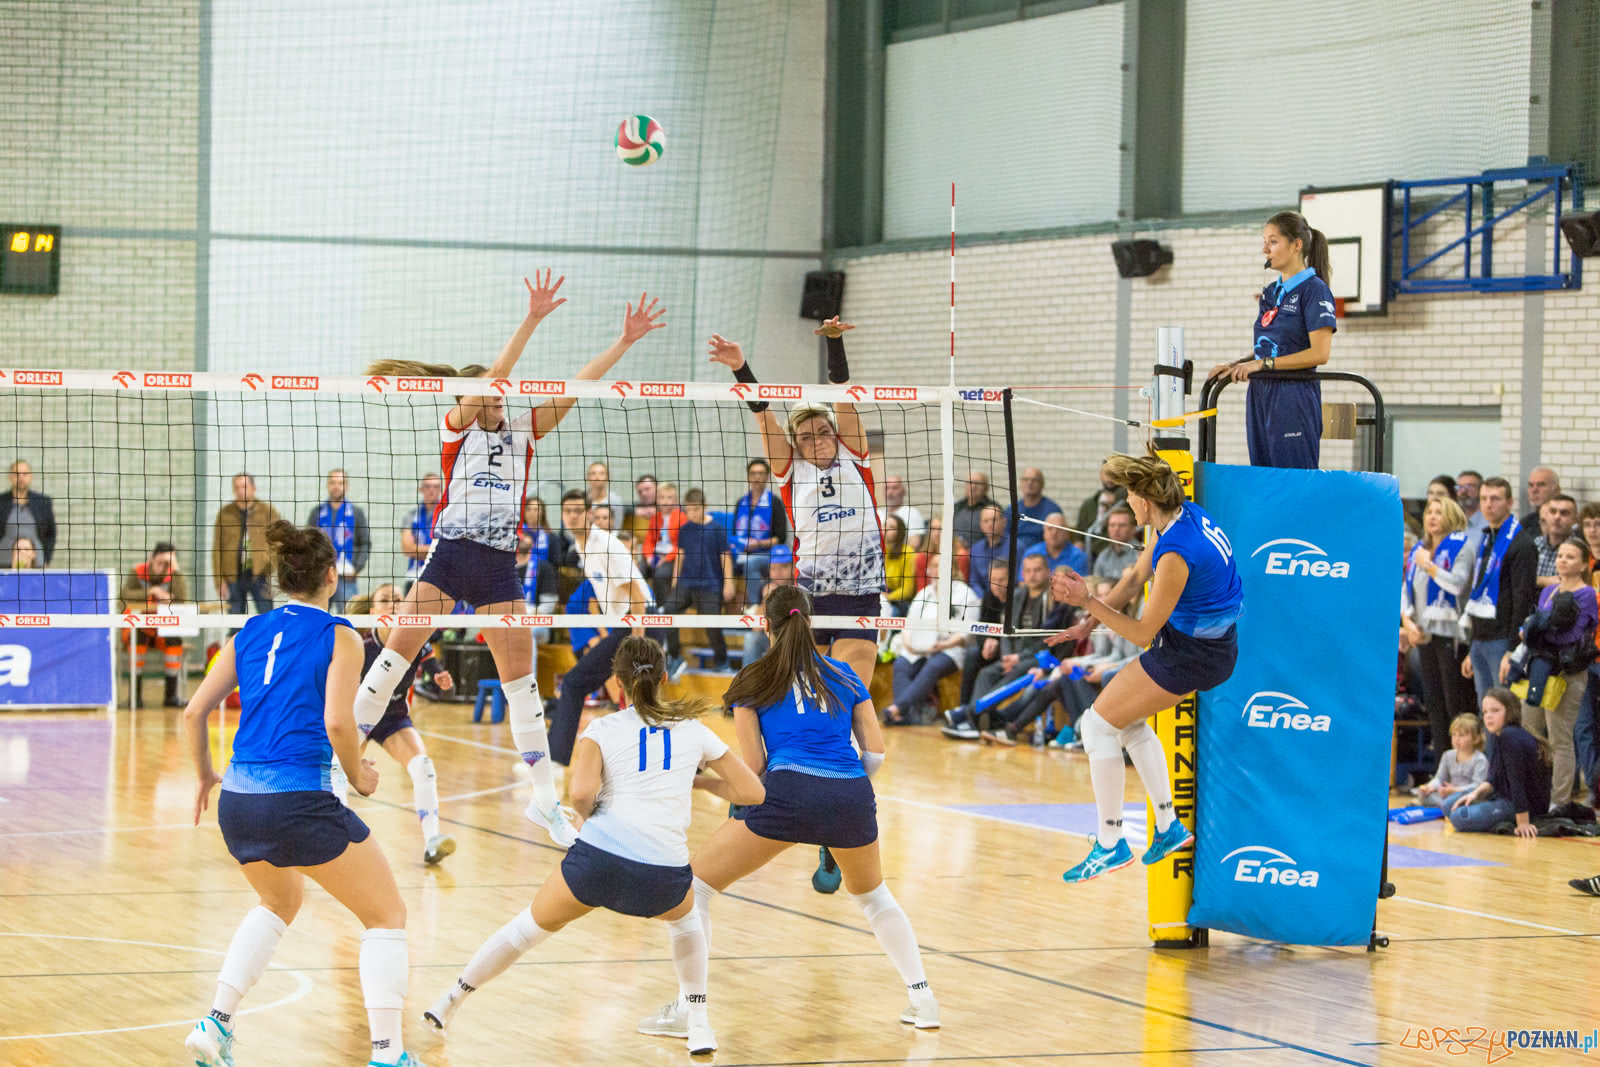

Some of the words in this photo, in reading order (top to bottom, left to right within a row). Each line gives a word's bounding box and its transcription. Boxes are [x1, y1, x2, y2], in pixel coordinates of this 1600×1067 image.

[16, 372, 60, 383] ORLEN
[147, 375, 189, 386] ORLEN
[274, 378, 317, 388] ORLEN
[399, 381, 441, 391] ORLEN
[522, 383, 563, 393] ORLEN
[642, 385, 682, 395] ORLEN
[760, 387, 800, 397] ORLEN
[876, 389, 915, 399] ORLEN
[958, 388, 1003, 401] netex
[488, 444, 504, 467] 2
[472, 478, 511, 491] Enea
[820, 476, 836, 498] 3
[818, 508, 856, 523] Enea
[1201, 516, 1233, 567] 16
[1265, 552, 1350, 579] Enea
[17, 616, 49, 625] ORLEN
[147, 616, 178, 625] ORLEN
[400, 616, 430, 625] ORLEN
[522, 616, 552, 625] ORLEN
[643, 616, 672, 625] ORLEN
[876, 619, 904, 627] ORLEN
[970, 623, 1003, 634] netex
[264, 631, 284, 685] 1
[1247, 705, 1331, 732] Enea
[1234, 859, 1319, 888] Enea
